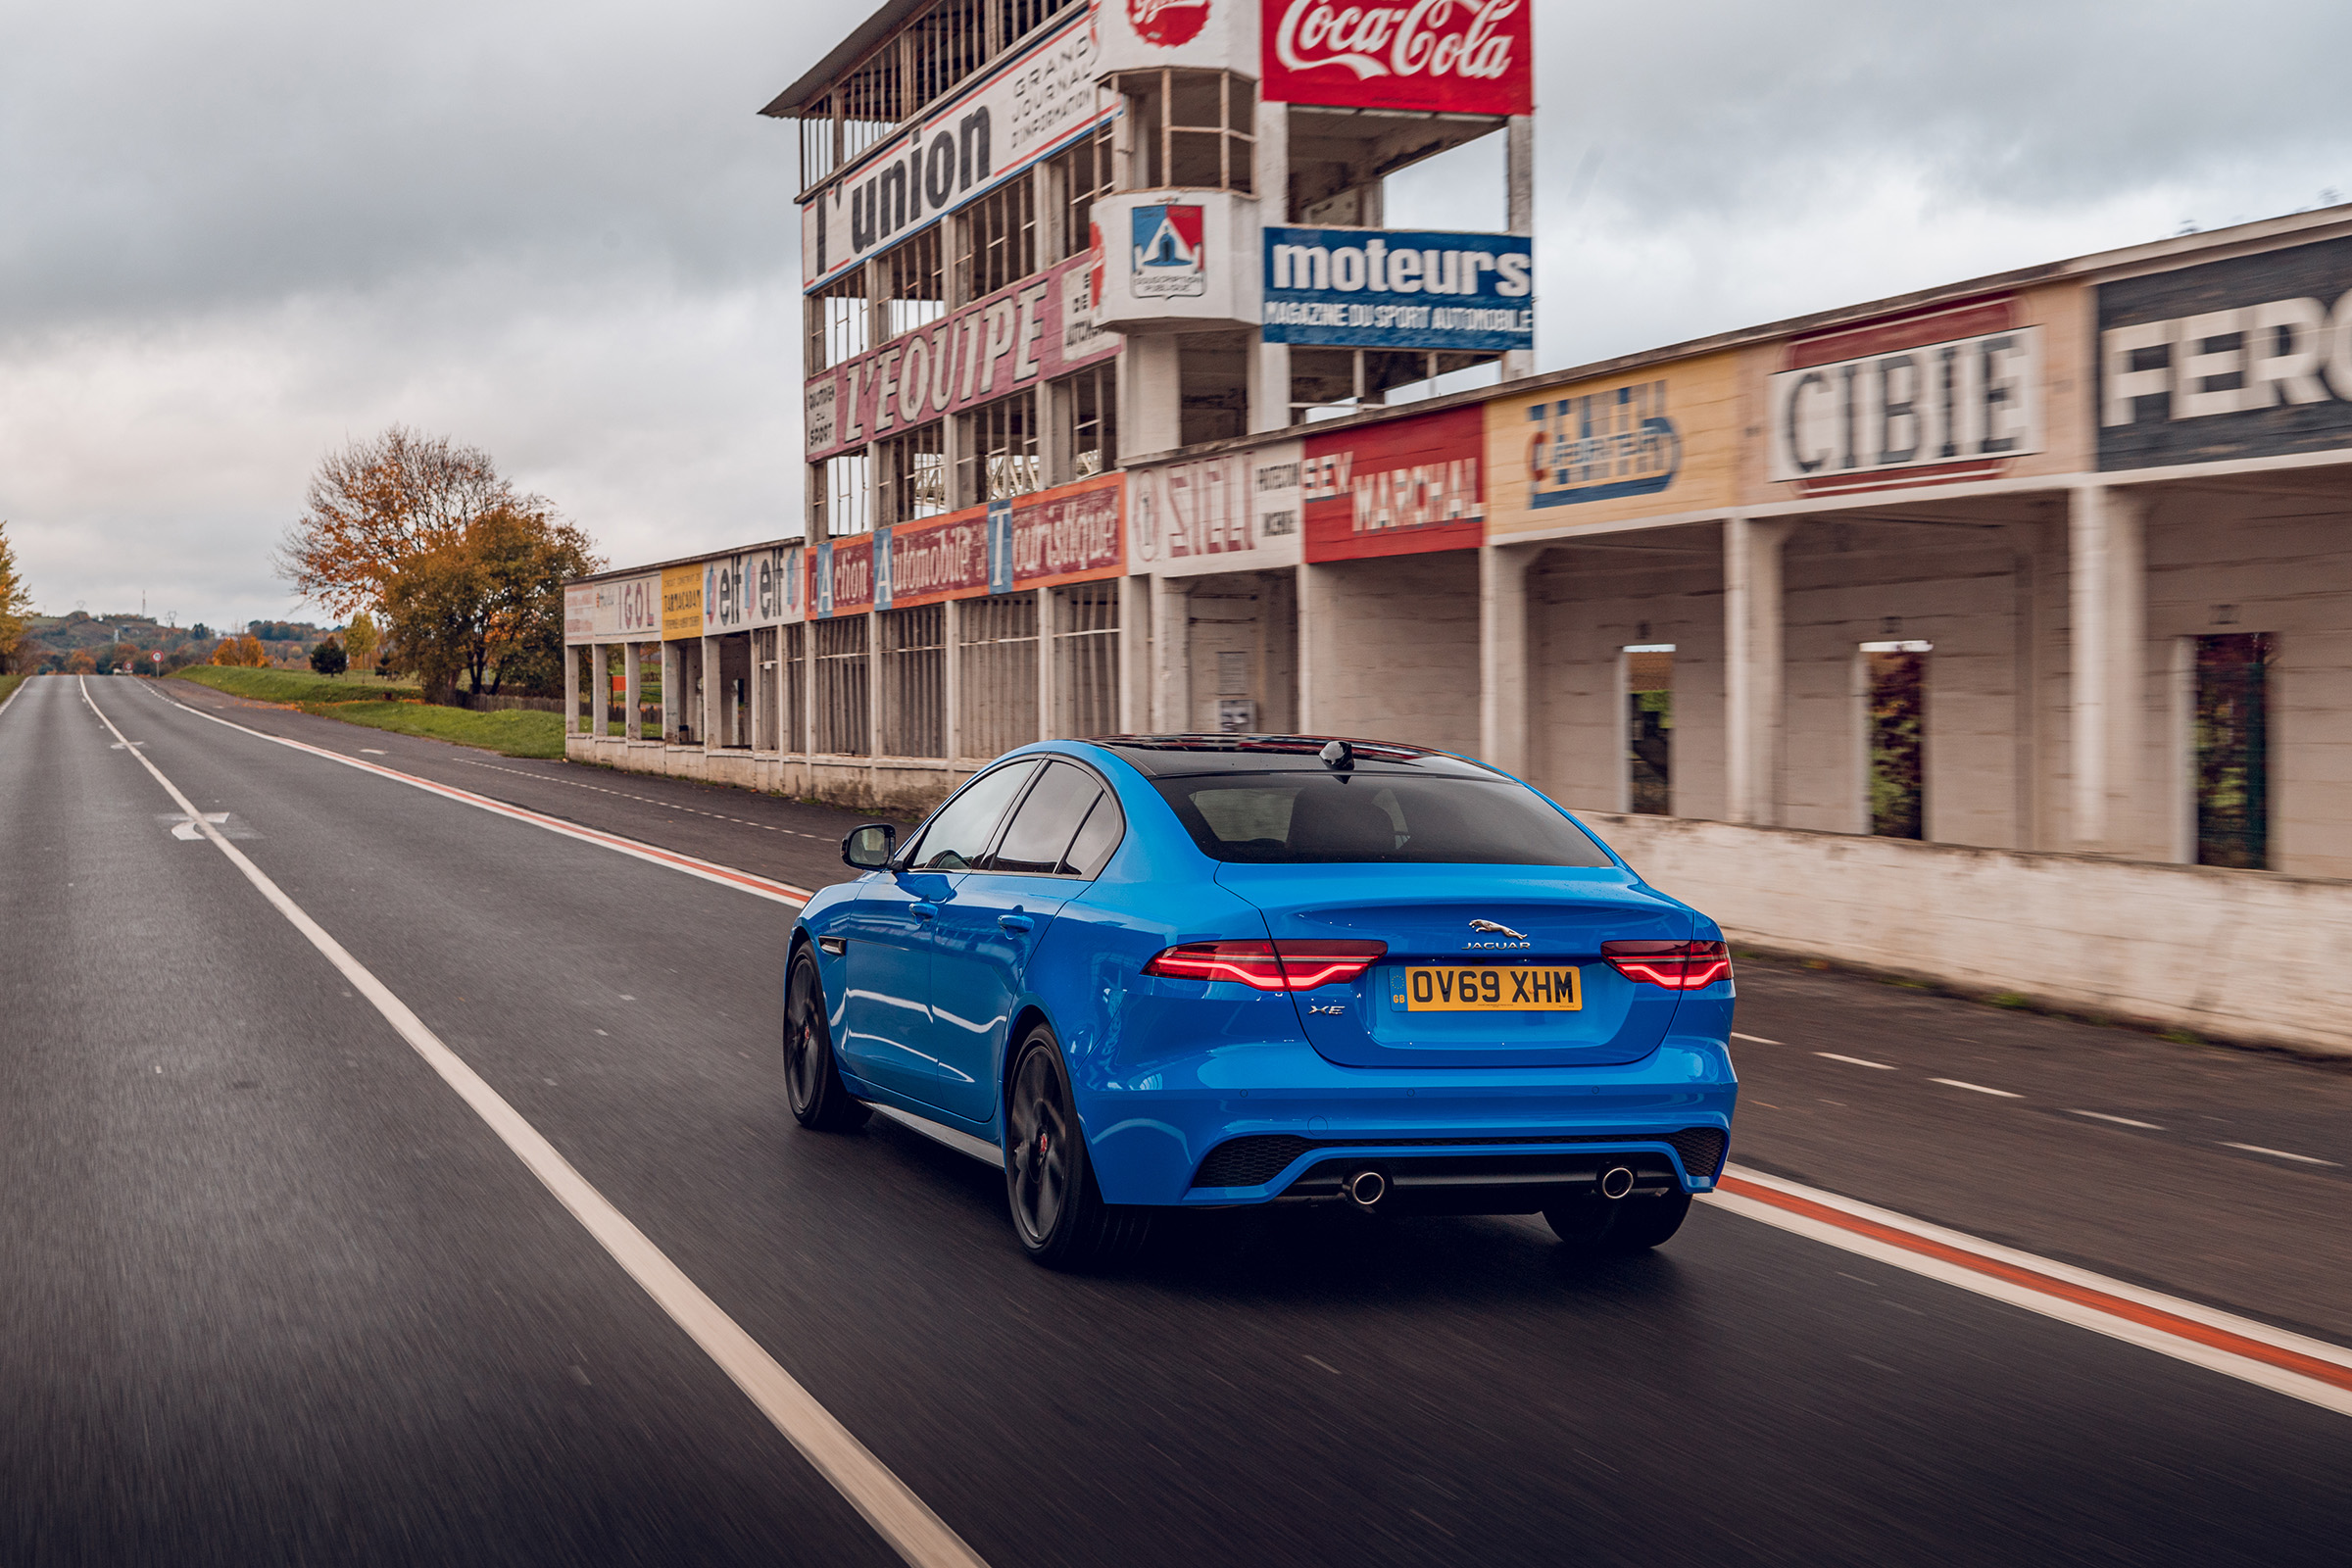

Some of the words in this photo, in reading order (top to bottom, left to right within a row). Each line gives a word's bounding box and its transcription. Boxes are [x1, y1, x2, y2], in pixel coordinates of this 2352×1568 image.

[1013, 35, 1090, 99] GRAND
[1276, 0, 1516, 81] Coca-Cola
[1010, 62, 1093, 123] JOURNAL
[1273, 238, 1532, 298] moteurs
[1264, 300, 1349, 327] MAGAZINE
[1348, 303, 1375, 328] DU
[1374, 304, 1431, 330] SPORT
[1432, 306, 1534, 333] AUTOMOBILE
[1352, 458, 1487, 532] MARCHAL
[719, 555, 742, 627] elf
[760, 549, 784, 620] elf
[1461, 941, 1531, 951] JAGUAR
[1306, 1004, 1347, 1015] XE
[1393, 995, 1405, 1004] GB
[1412, 970, 1501, 1004] OV69
[1511, 970, 1574, 1004] XHM
